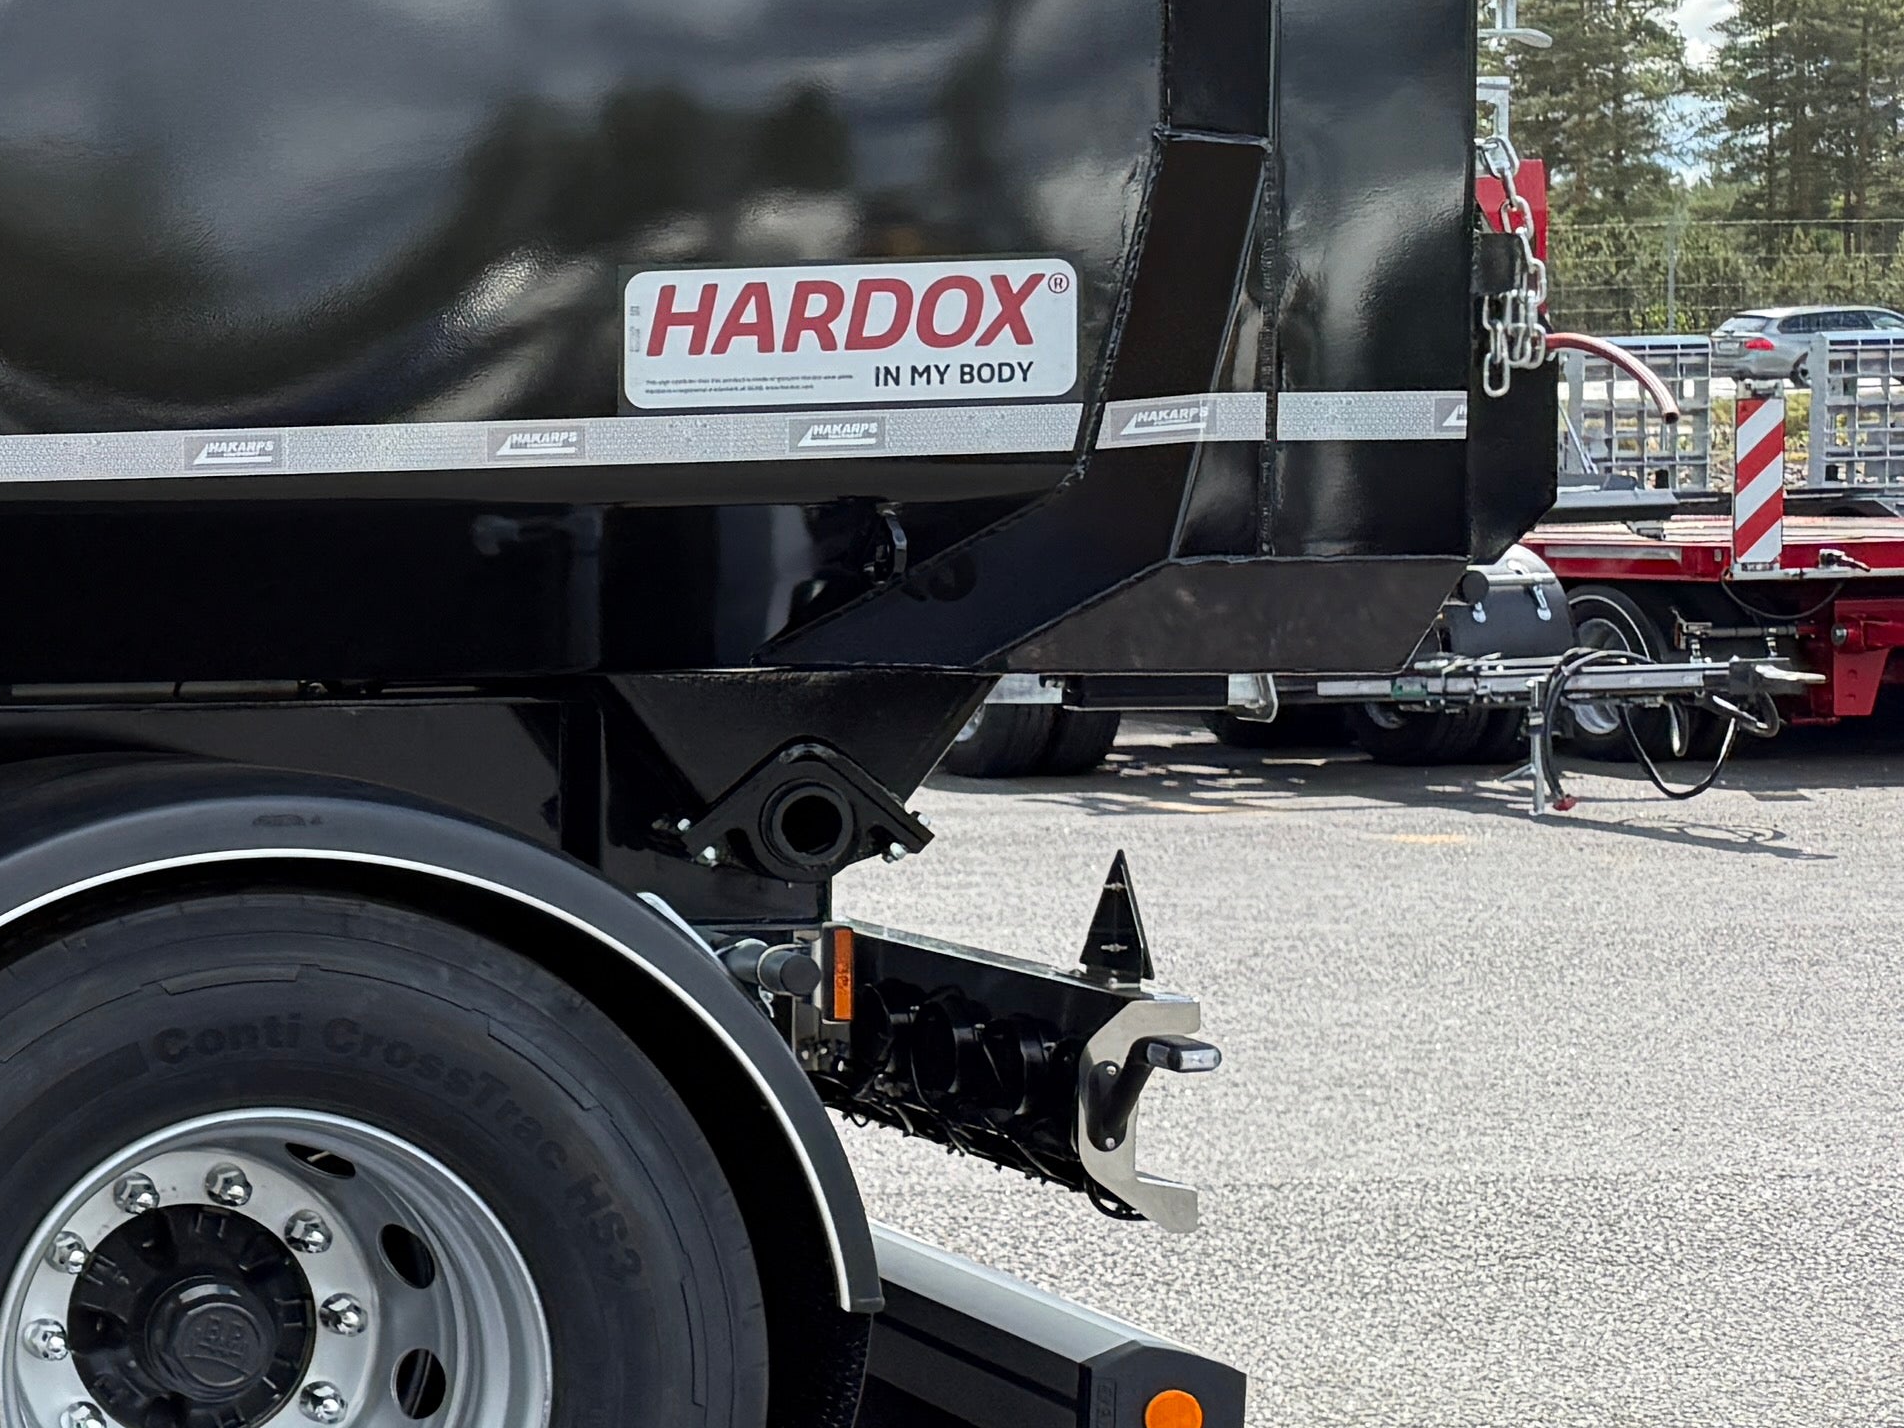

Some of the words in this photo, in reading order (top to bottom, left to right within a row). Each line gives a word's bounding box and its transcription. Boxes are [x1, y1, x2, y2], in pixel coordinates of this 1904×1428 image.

[875, 365, 900, 387] IN
[910, 363, 951, 386] MY
[959, 361, 1035, 385] BODY
[152, 1013, 302, 1064] Conti
[322, 1017, 568, 1172] CrossTrac
[565, 1172, 642, 1276] HS3
